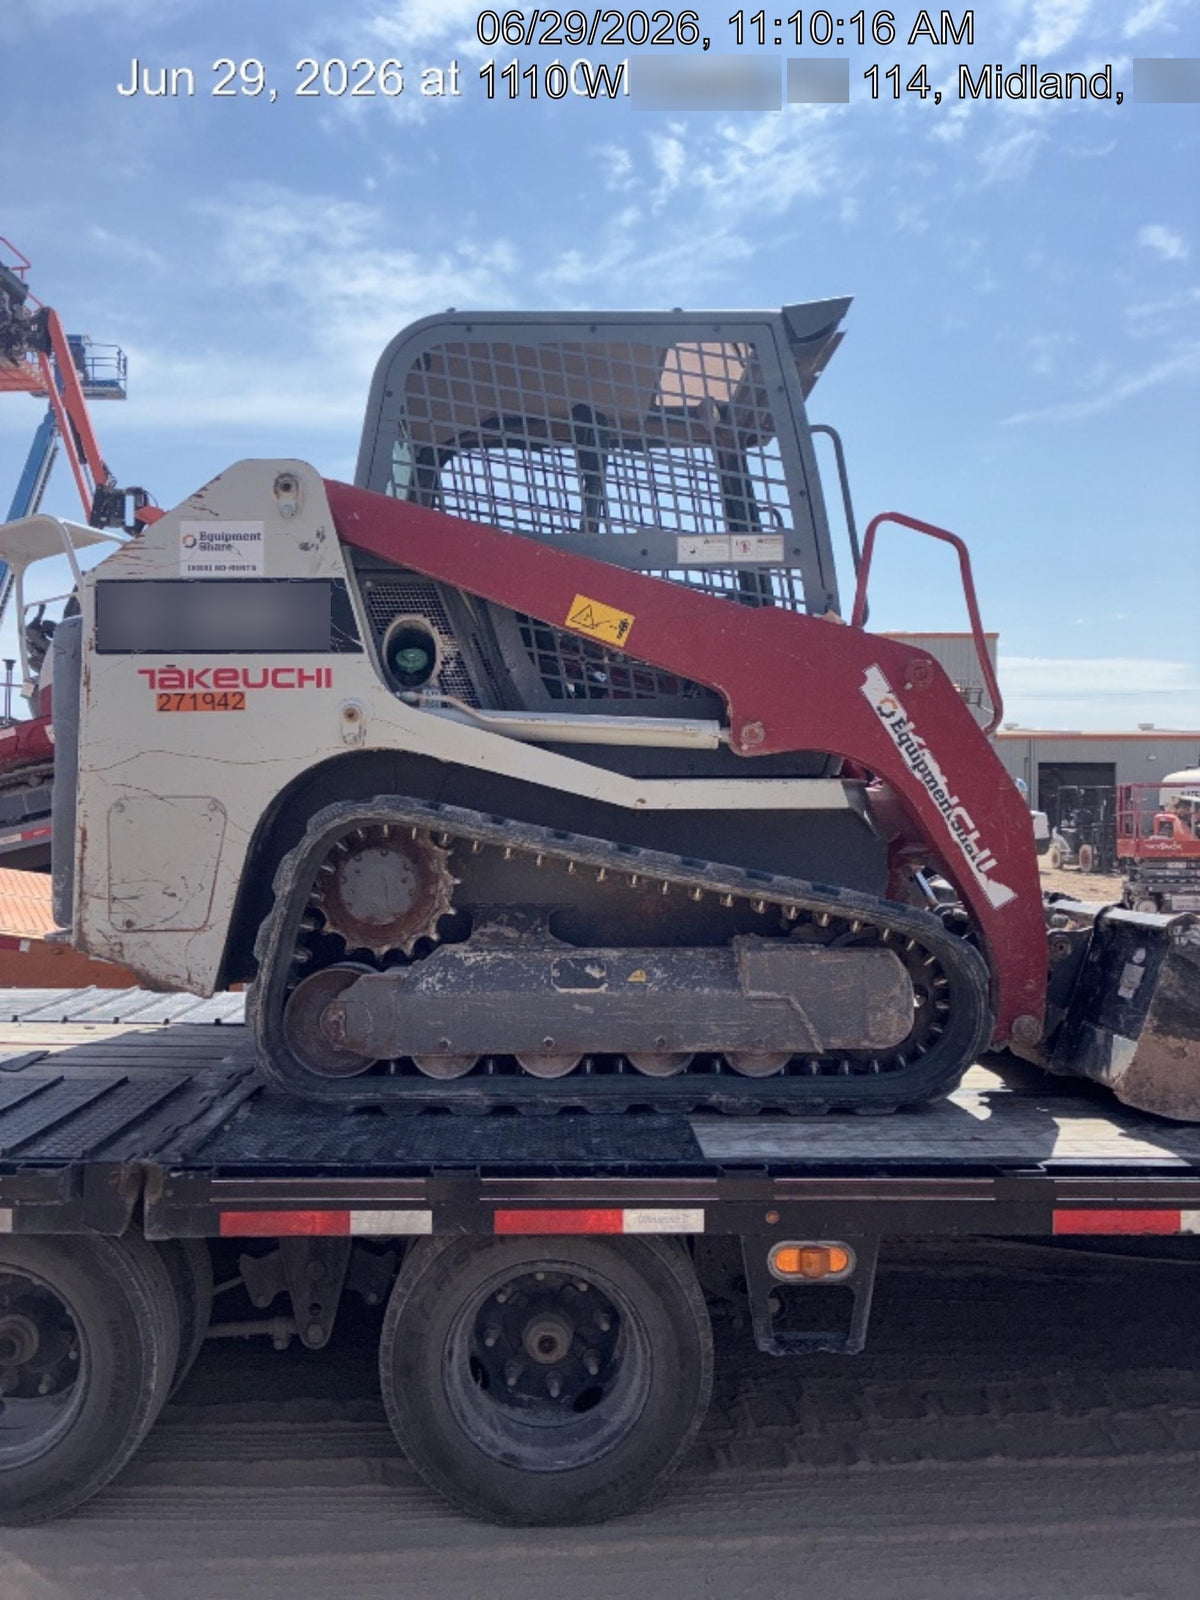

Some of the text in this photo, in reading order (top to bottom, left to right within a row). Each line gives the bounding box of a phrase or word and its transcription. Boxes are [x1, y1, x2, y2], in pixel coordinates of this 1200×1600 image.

[199, 531, 262, 542] Equipment
[199, 541, 233, 551] Share
[158, 692, 245, 711] 271942
